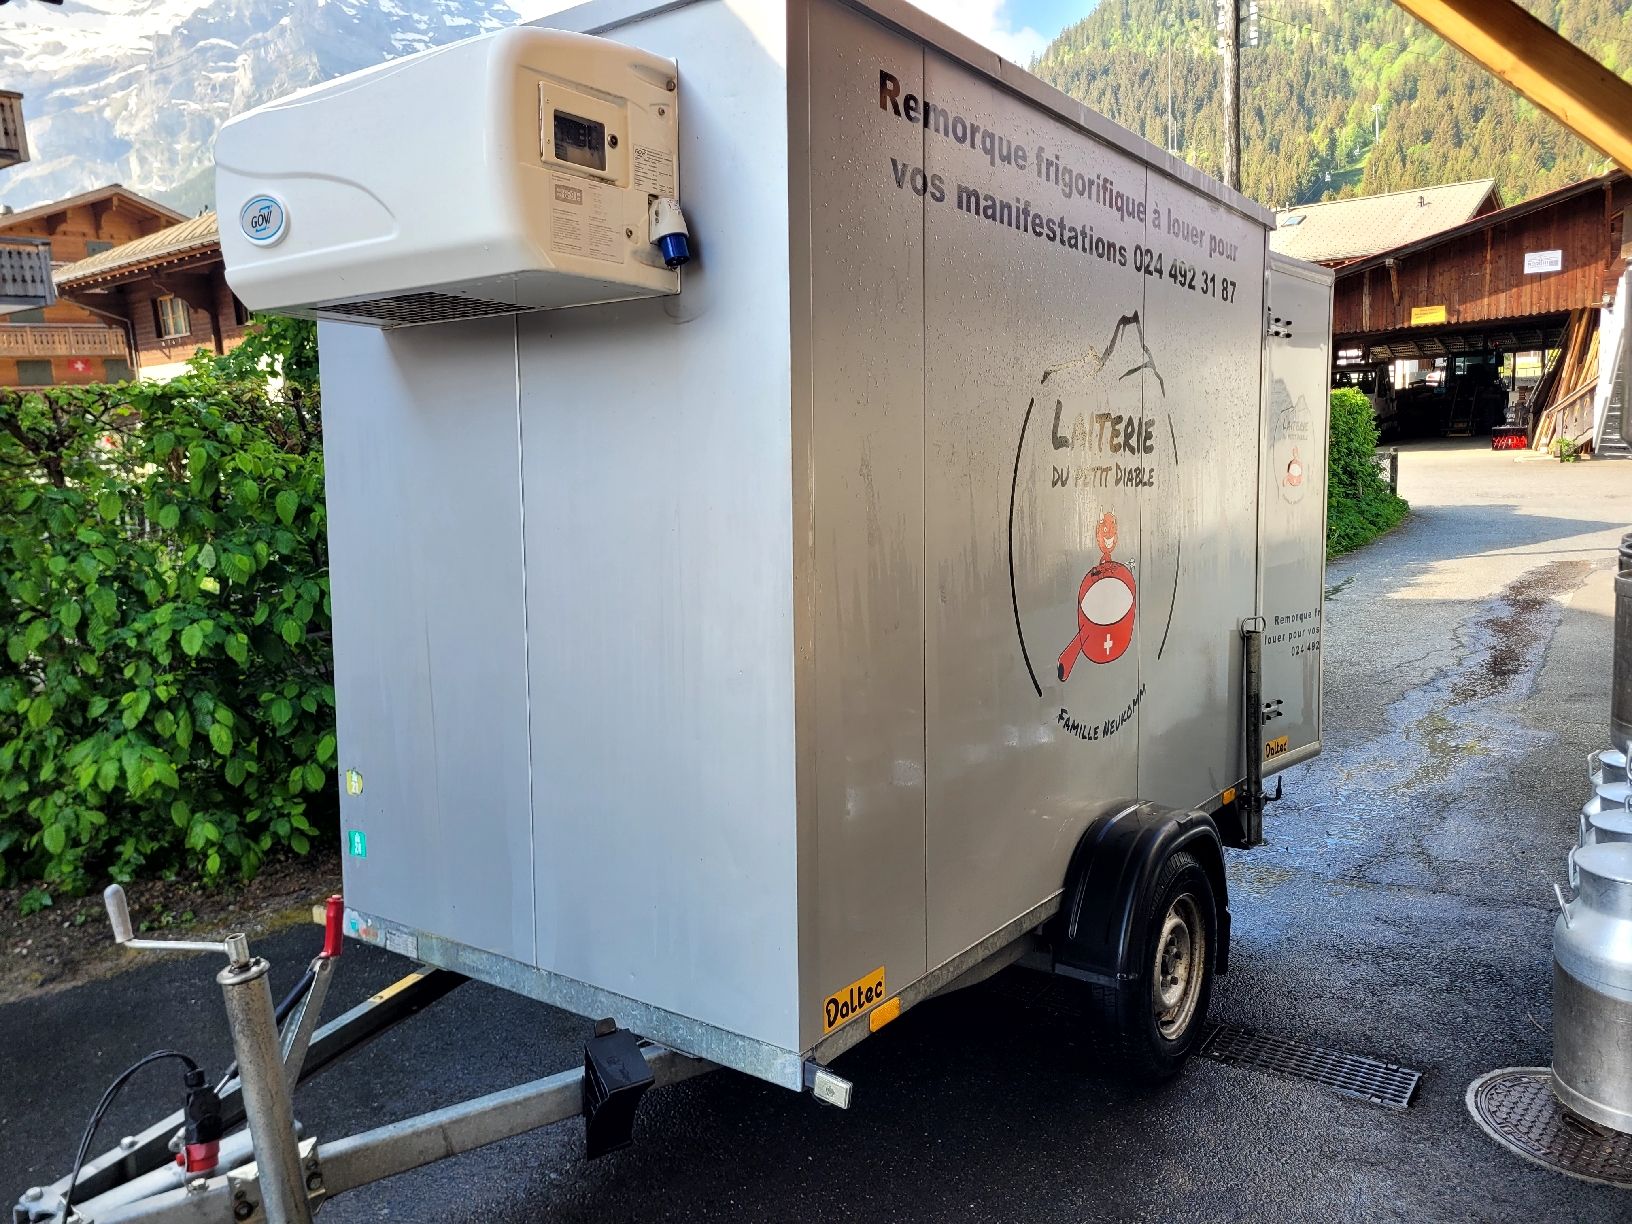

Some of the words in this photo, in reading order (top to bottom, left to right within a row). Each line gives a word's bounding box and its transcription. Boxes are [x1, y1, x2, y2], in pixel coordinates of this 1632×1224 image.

[879, 69, 1028, 171] Remorque
[1035, 145, 1147, 223] frigorifique
[1151, 202, 1162, 230] à
[1167, 206, 1206, 255] louer
[1209, 235, 1239, 263] pour
[890, 157, 946, 203] vos
[957, 183, 1127, 267] manifestations
[1134, 243, 1163, 280] 024
[1168, 258, 1197, 292] 492
[1201, 270, 1216, 298] 31
[1221, 277, 1237, 304] 87
[1051, 399, 1155, 457] LAITERIE
[1052, 464, 1070, 488] DU
[1114, 461, 1155, 489] DIABLE
[1274, 611, 1312, 626] Remorque
[1264, 633, 1286, 646] louer
[1288, 629, 1306, 643] pour
[1307, 626, 1320, 636] vos
[1057, 707, 1100, 741] FAMILLE
